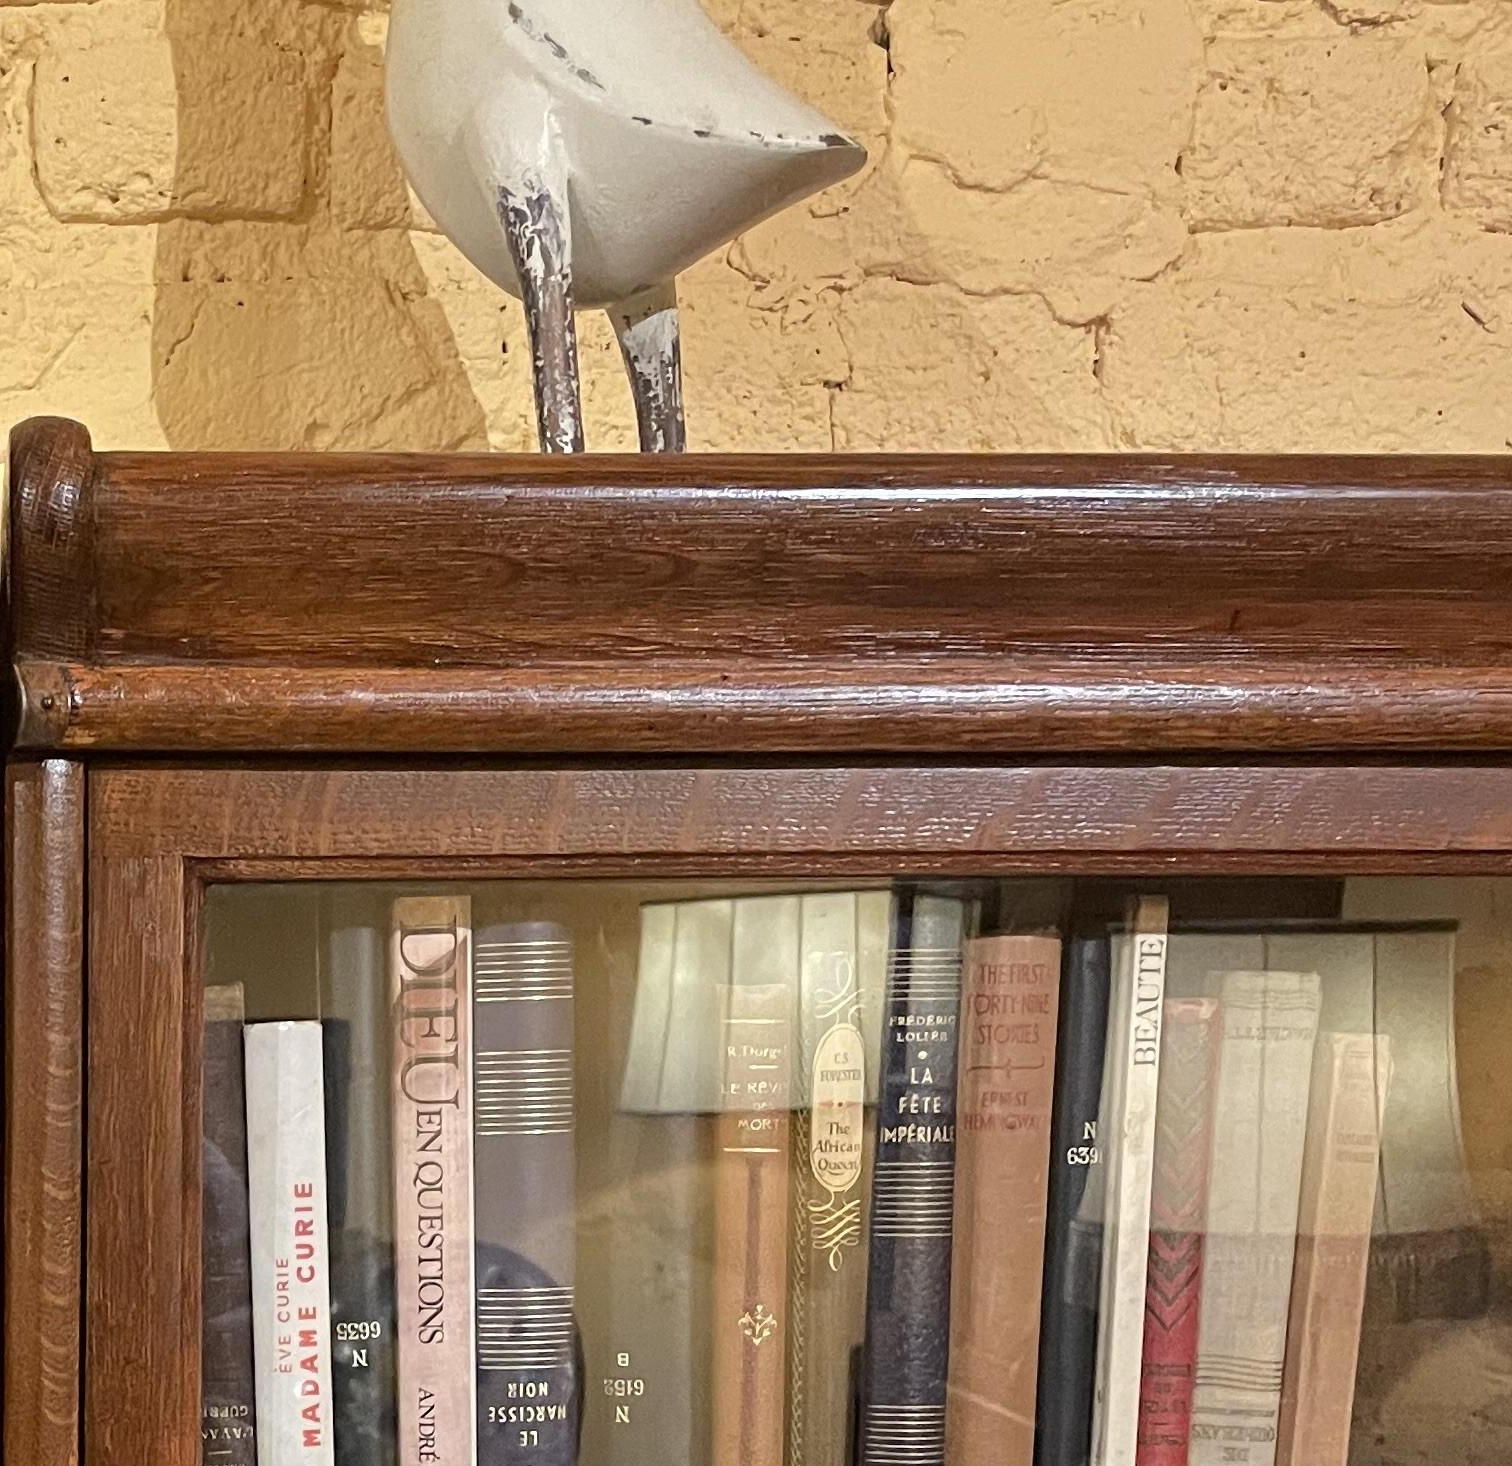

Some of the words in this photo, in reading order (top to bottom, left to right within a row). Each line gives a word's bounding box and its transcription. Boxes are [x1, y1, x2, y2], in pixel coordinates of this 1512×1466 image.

[980, 963, 1007, 985] THE
[1009, 963, 1046, 985] FIRST
[399, 914, 459, 1109] DIEU
[977, 1023, 1039, 1045] STORIES
[910, 1067, 934, 1085] LA
[898, 1093, 941, 1114] FÊTE
[981, 1091, 1029, 1108] ERNEST
[416, 1107, 443, 1154] EN
[827, 1121, 850, 1135] The
[964, 1112, 1047, 1131] HEMINGWAY
[1083, 1121, 1097, 1140] N
[814, 1139, 861, 1153] African
[294, 1183, 316, 1284] CURIE
[413, 1160, 445, 1345] QUESTIONS
[276, 1258, 291, 1323] CURIE
[336, 1320, 381, 1340] 6635
[351, 1349, 368, 1367] N
[298, 1306, 322, 1447] MADAME
[507, 1381, 548, 1398] NOIR
[488, 1404, 567, 1423] NARCISSE
[615, 1405, 630, 1424] N
[417, 1387, 440, 1462] ANDRÉ
[519, 1430, 538, 1447] LE
